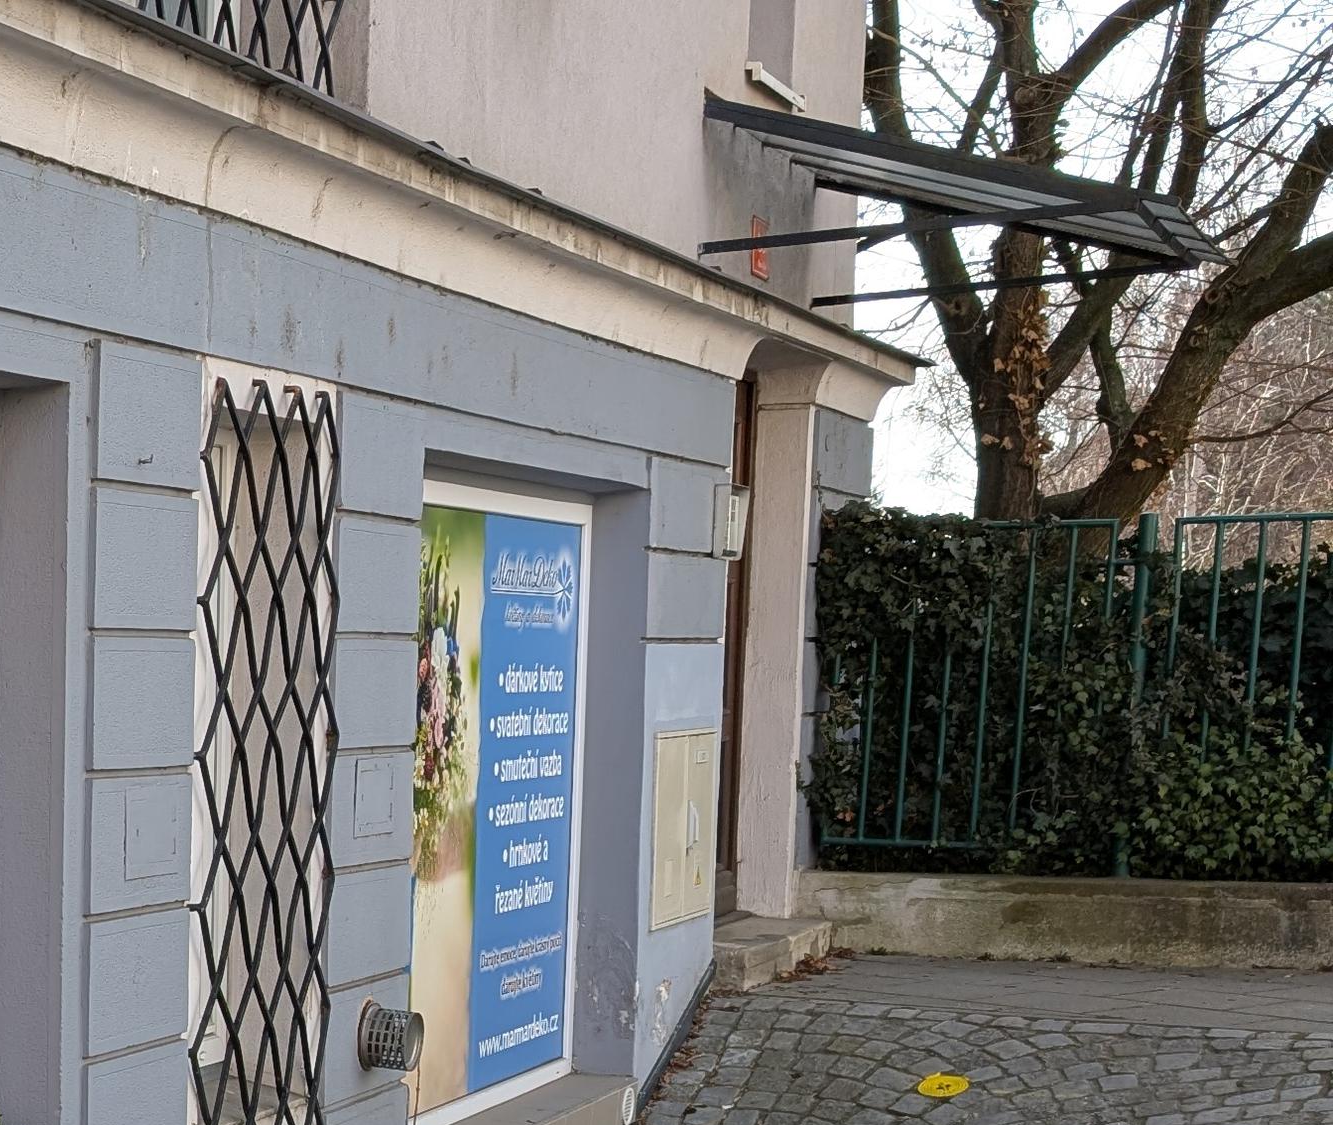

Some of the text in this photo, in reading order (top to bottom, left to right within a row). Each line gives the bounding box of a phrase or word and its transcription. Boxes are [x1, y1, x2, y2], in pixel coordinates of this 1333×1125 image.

[505, 663, 564, 693] dárkové kytice
[496, 706, 569, 738] svatební dekorace
[500, 749, 562, 783] smuteční vazba
[495, 793, 565, 827] sezónní dekorace
[509, 834, 549, 868] hrnkové a
[495, 876, 554, 914] řezané květiny
[478, 1011, 559, 1058] www.marmardeko.cz
